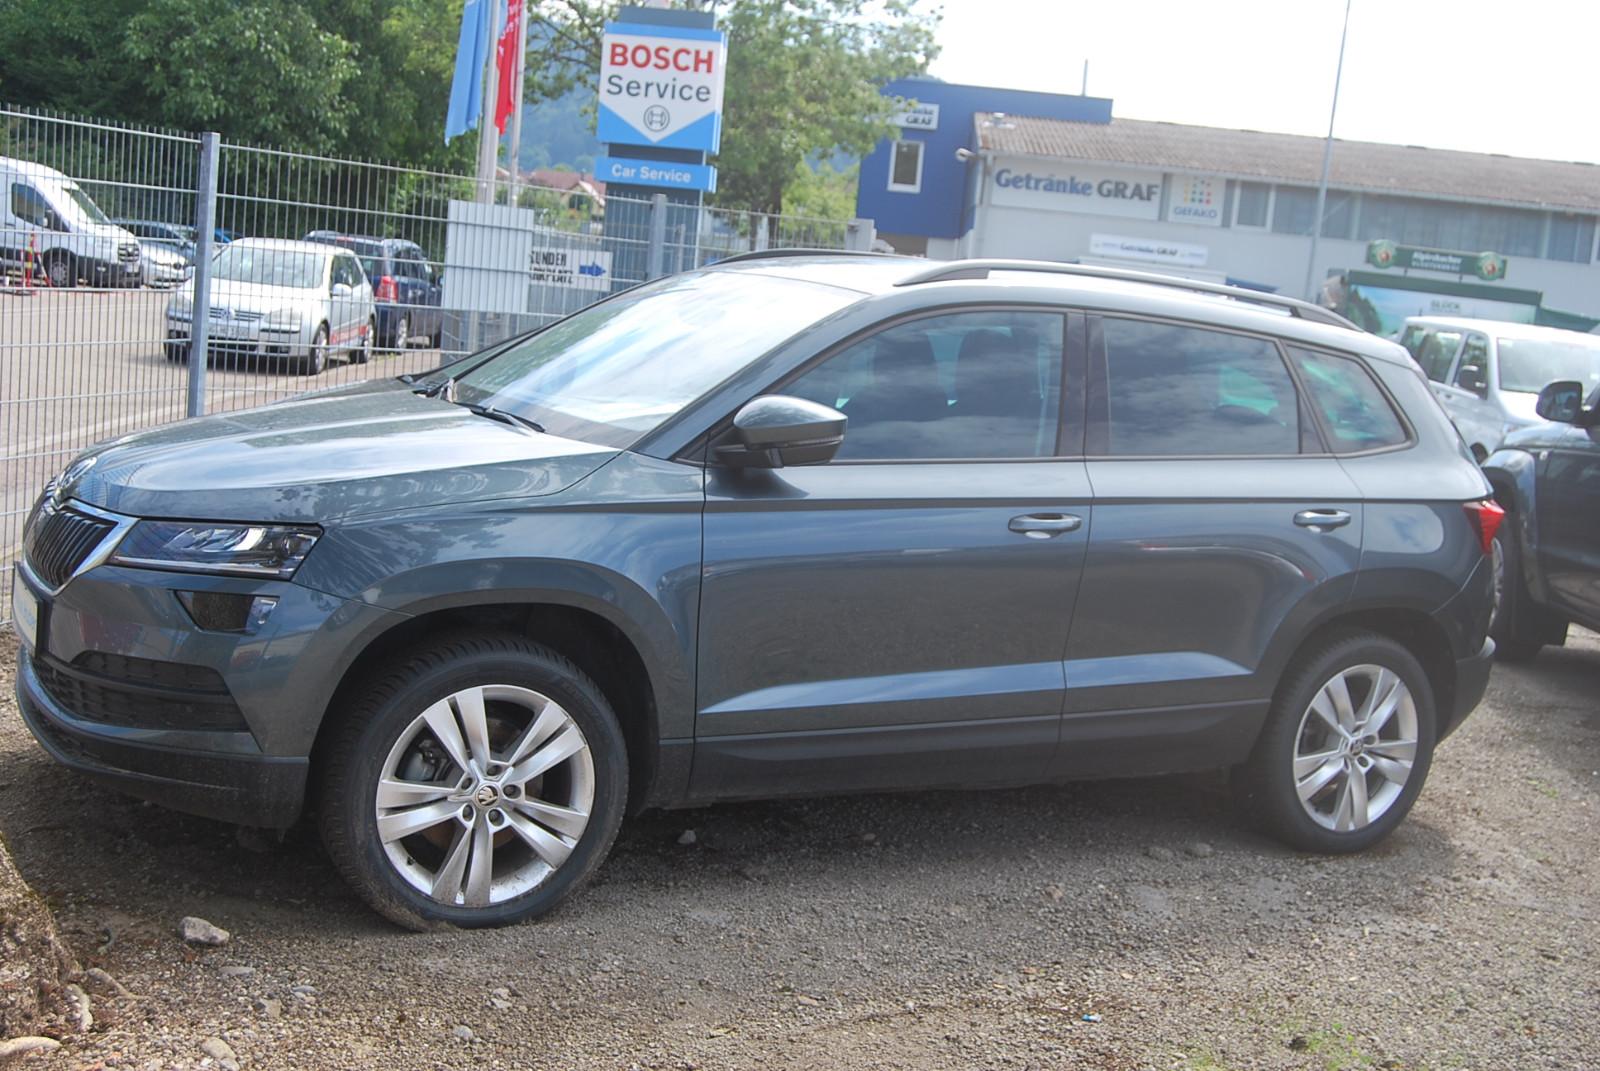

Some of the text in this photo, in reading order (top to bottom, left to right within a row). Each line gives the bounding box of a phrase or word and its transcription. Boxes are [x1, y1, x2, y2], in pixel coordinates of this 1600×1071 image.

[609, 43, 713, 73] BOSCH
[606, 74, 711, 102] Service
[611, 163, 691, 183] Car Service
[995, 168, 1160, 201] Getränke GRAF
[1173, 206, 1217, 219] GEFAKO
